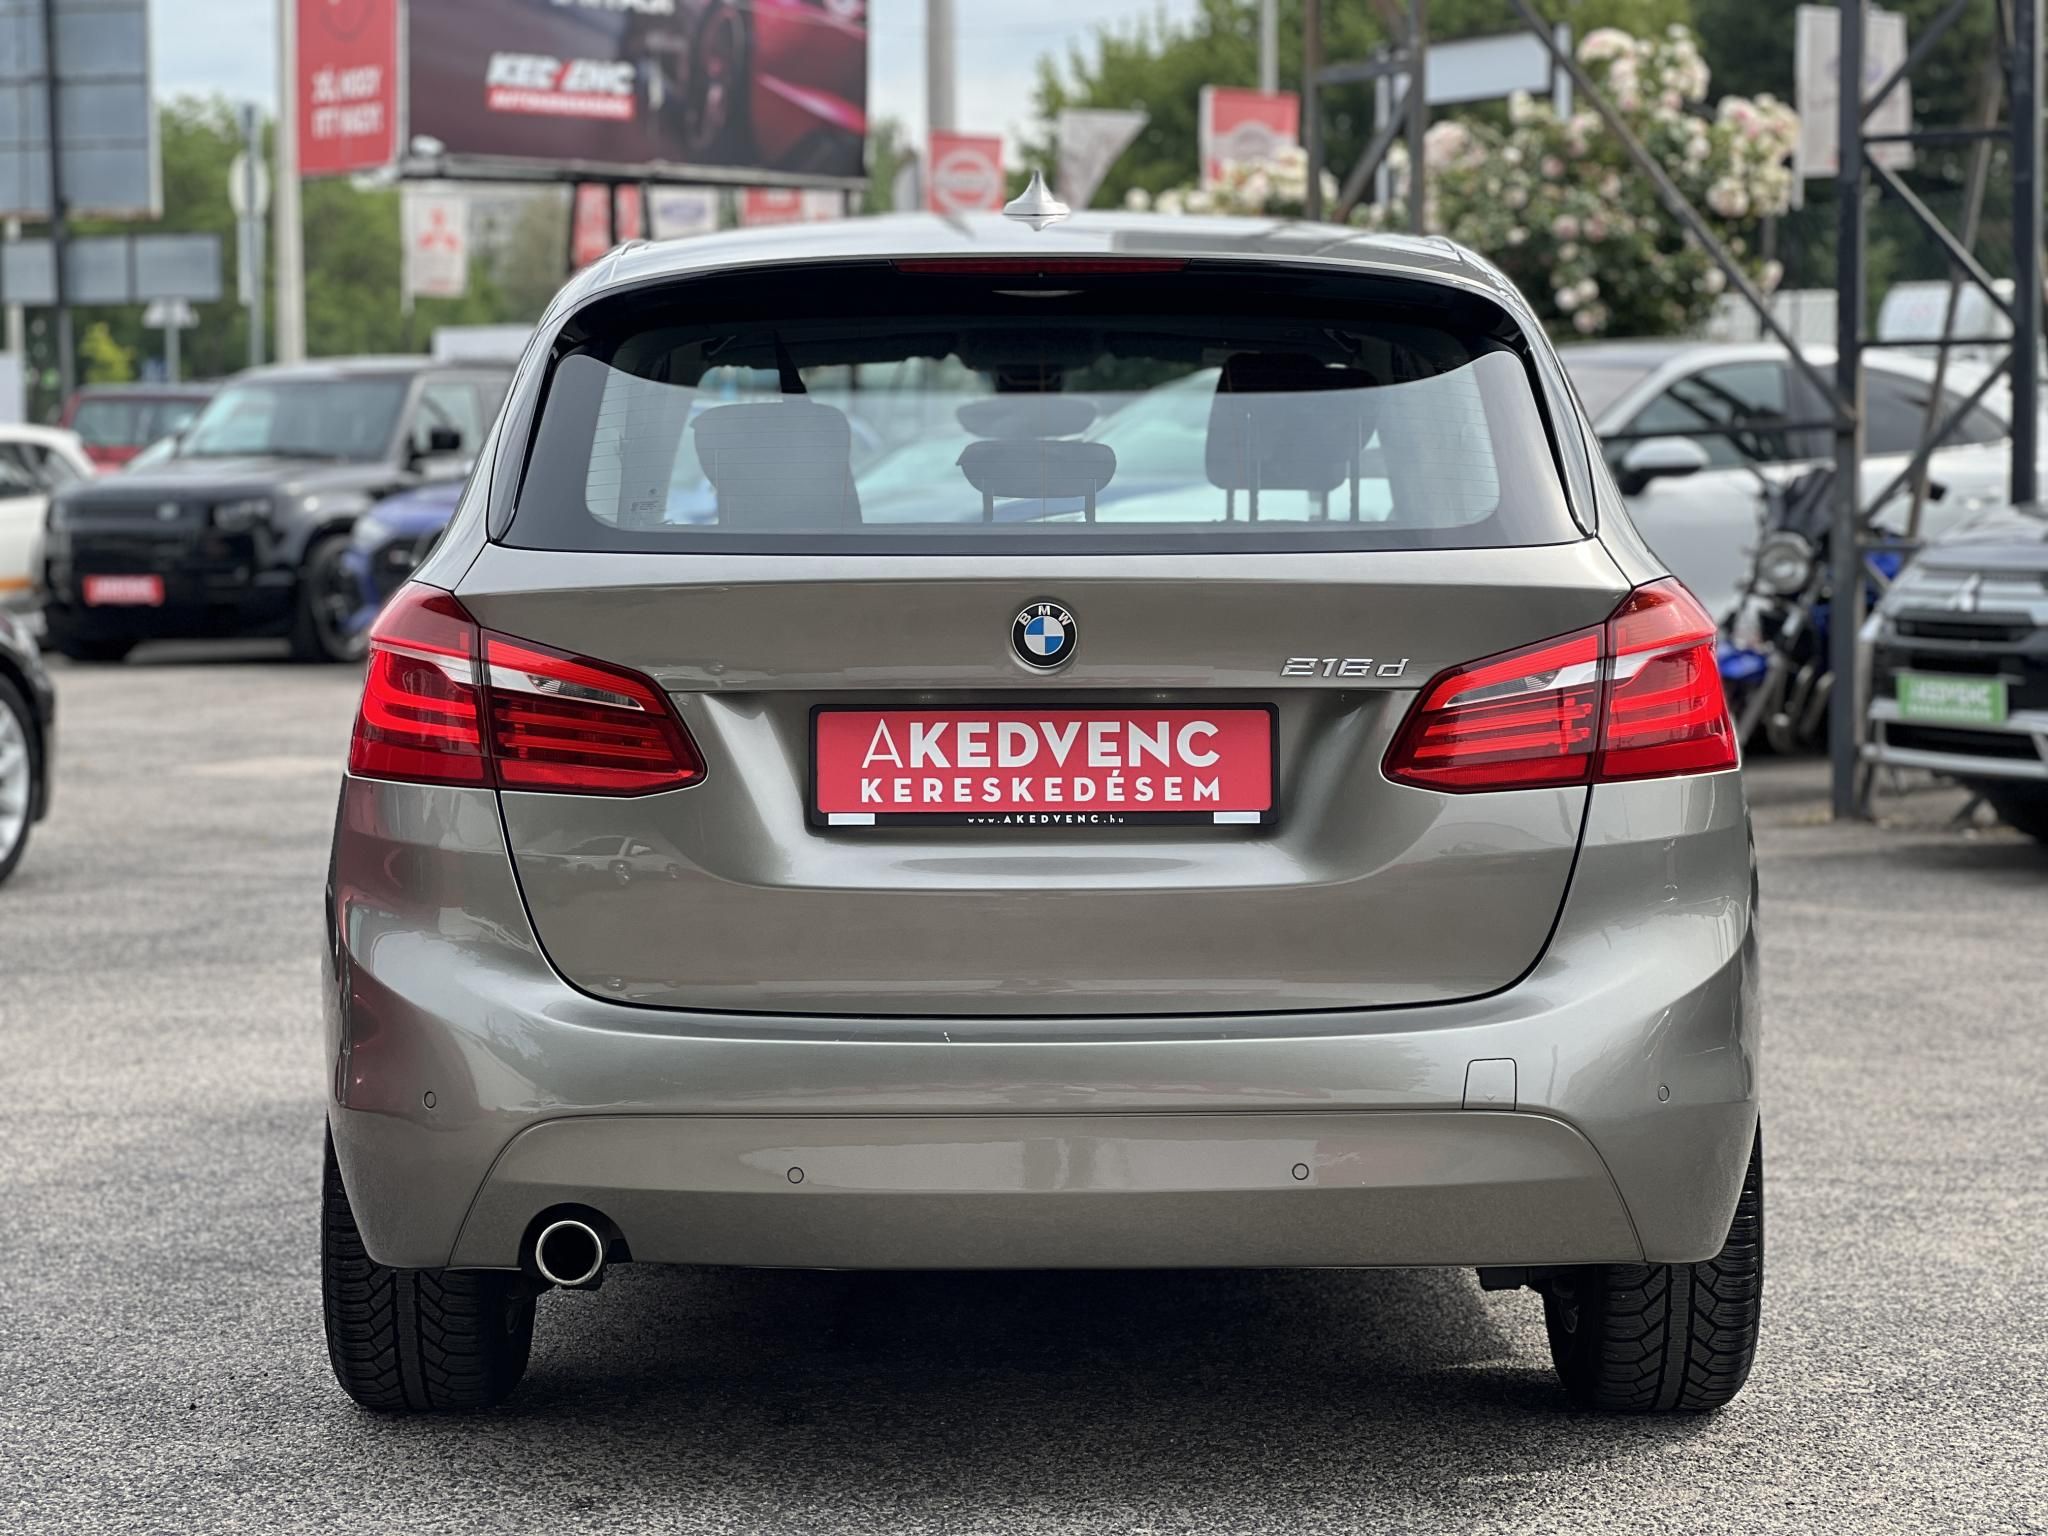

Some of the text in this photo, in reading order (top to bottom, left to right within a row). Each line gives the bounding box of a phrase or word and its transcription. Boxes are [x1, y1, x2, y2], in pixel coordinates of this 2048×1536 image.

[1018, 605, 1071, 626] BMW
[1280, 657, 1410, 677] 216d
[861, 718, 1221, 769] AKEDVENC
[861, 769, 1220, 803] KERESKEDÉSEM
[967, 814, 1124, 824] www.AKEDVENC.hu
